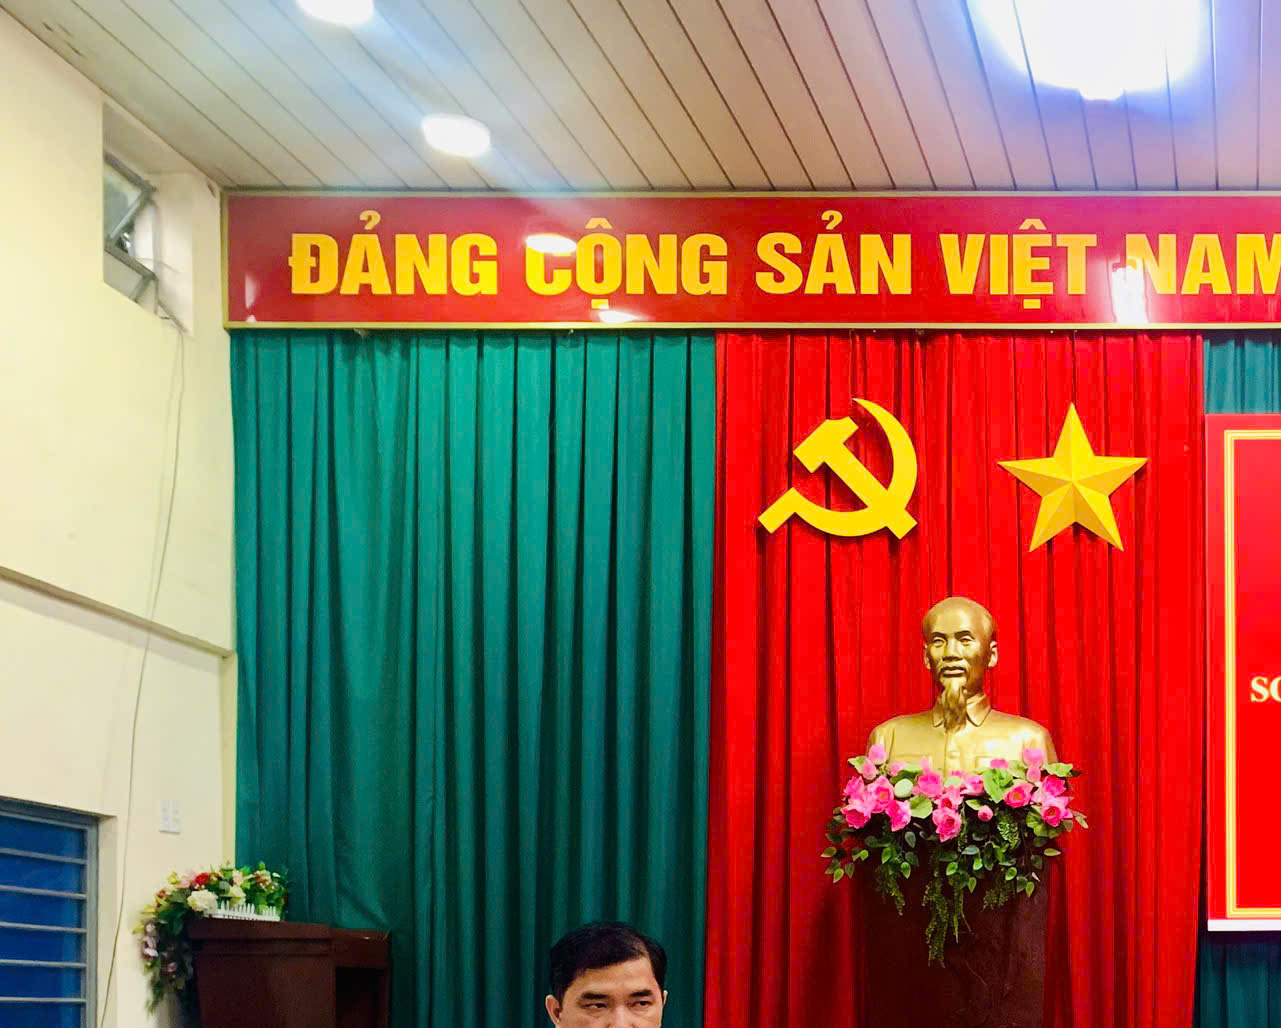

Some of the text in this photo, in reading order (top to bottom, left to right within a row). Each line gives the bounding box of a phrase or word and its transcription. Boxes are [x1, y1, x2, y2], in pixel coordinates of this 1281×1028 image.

[288, 211, 498, 296] ĐẢNG
[525, 217, 728, 309] CỘNG
[755, 210, 912, 295] SẢN
[939, 218, 1098, 309] VIỆT
